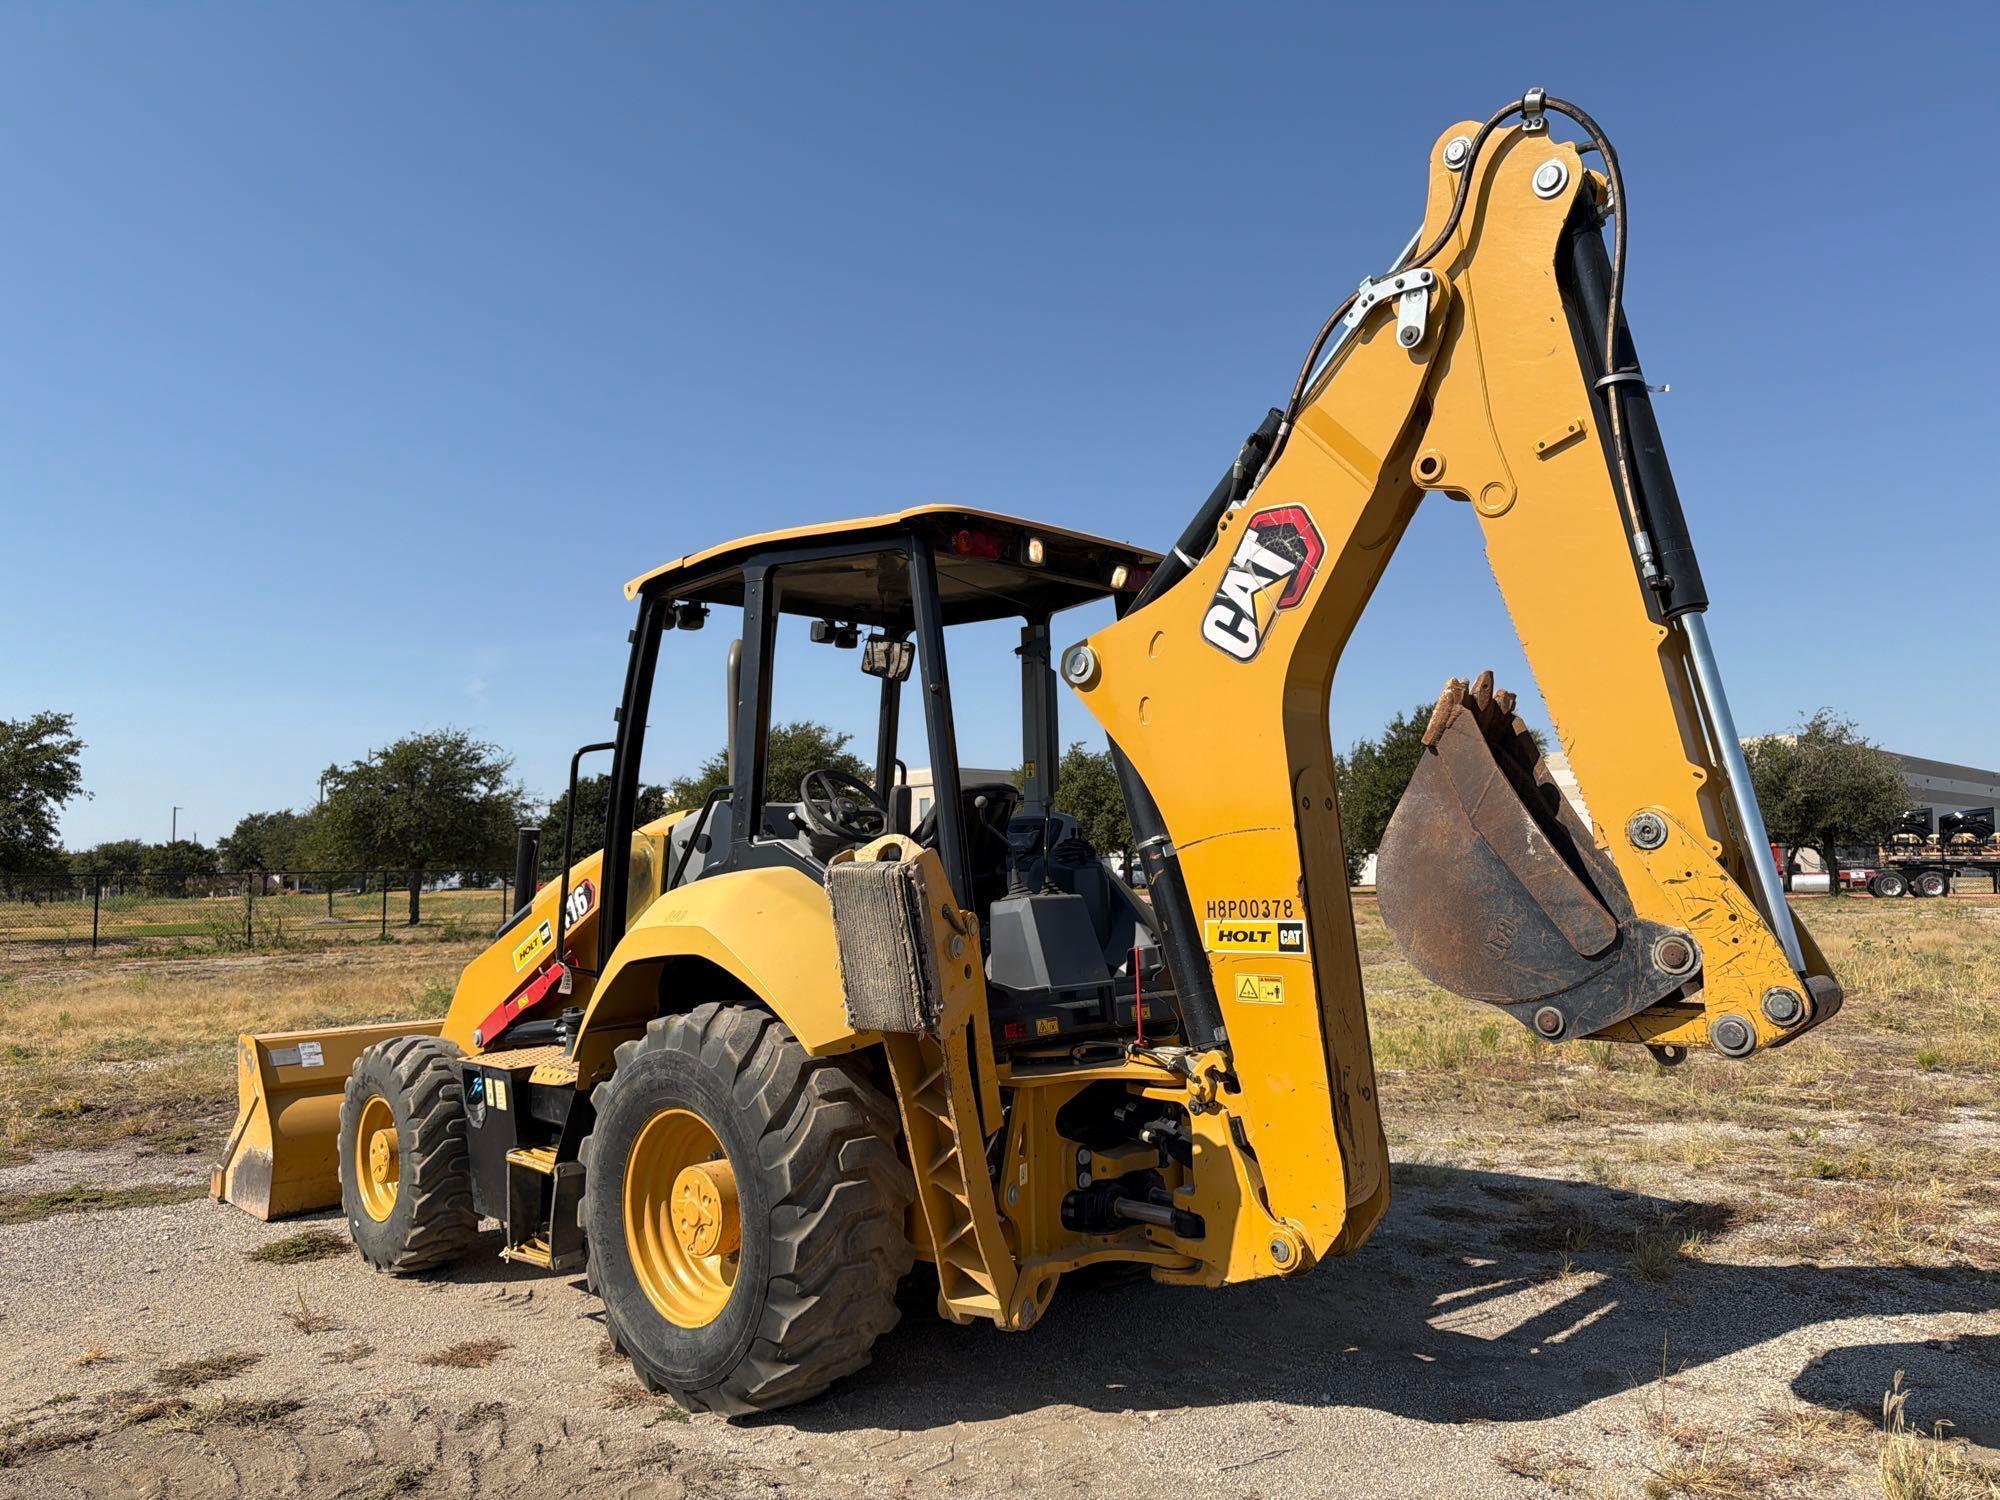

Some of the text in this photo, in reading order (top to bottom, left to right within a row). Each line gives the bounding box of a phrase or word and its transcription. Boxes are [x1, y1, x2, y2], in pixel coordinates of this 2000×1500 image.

[1203, 528, 1296, 659] CAT
[564, 886, 588, 929] 16
[1207, 899, 1293, 918] H8P00378
[519, 937, 539, 960] HOLT
[1218, 929, 1302, 945] HOLT CAT
